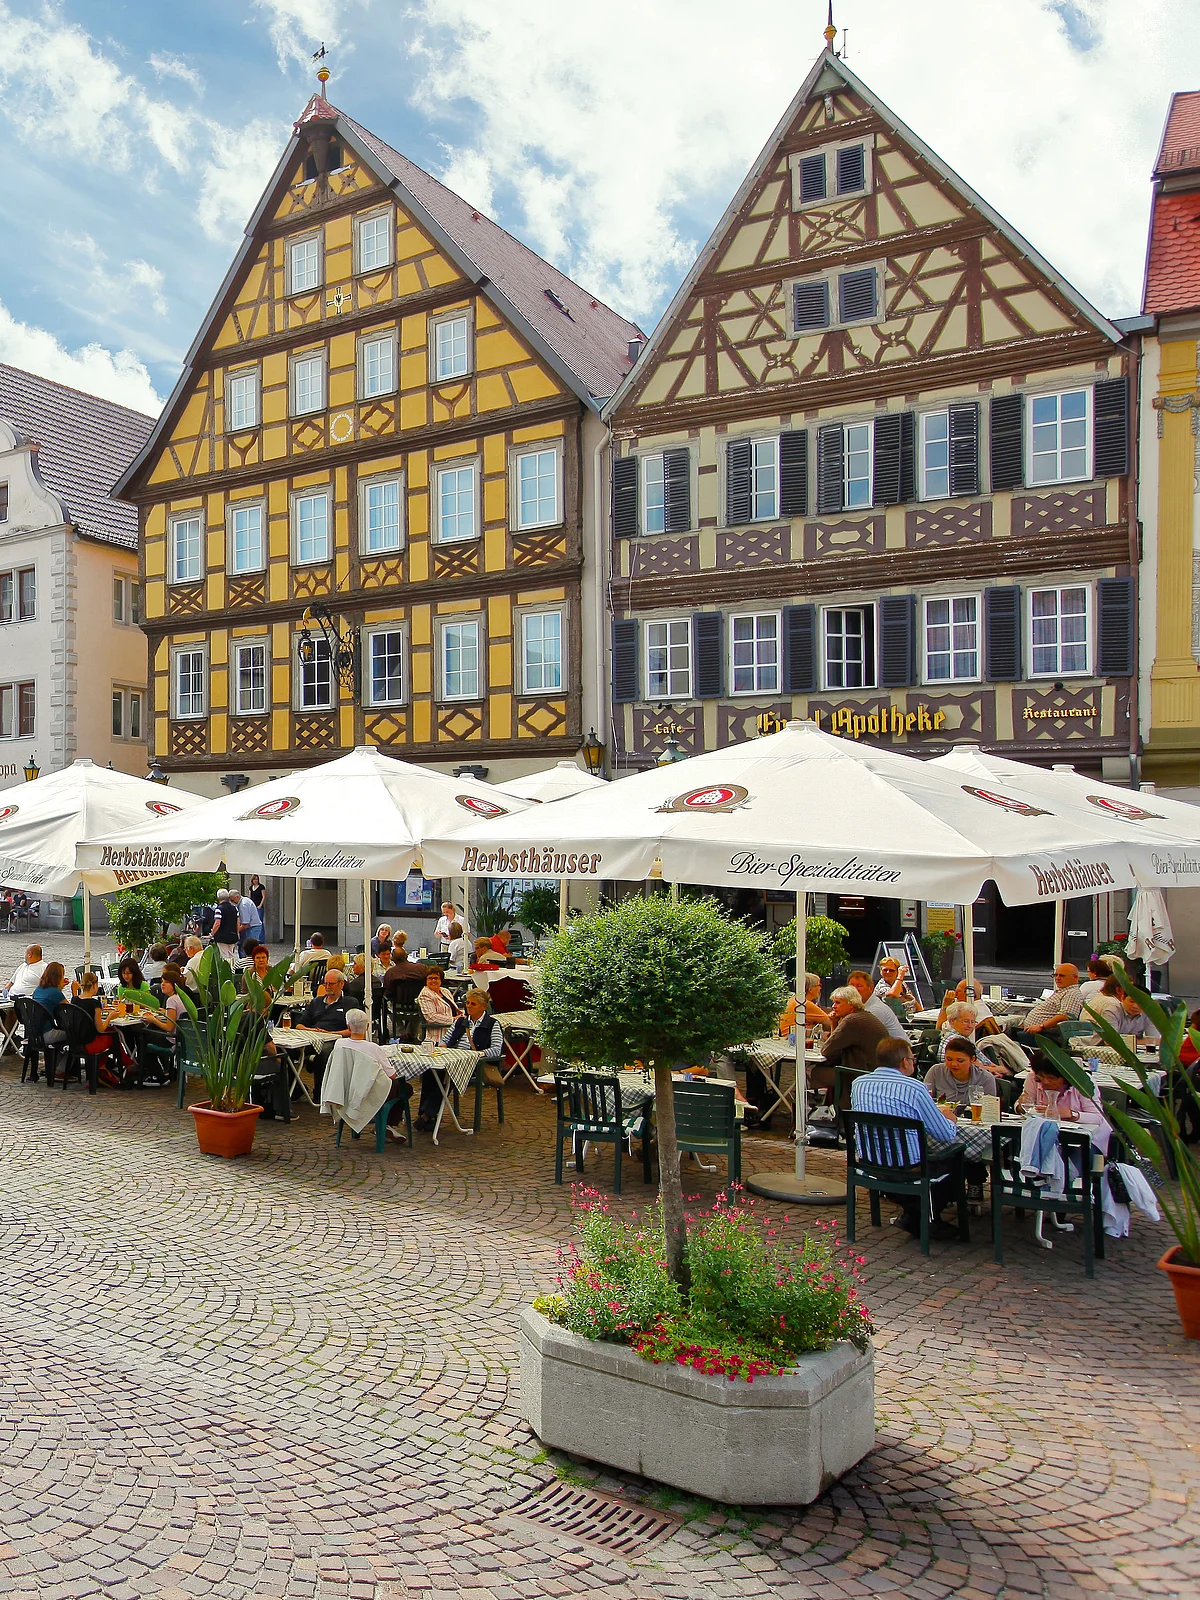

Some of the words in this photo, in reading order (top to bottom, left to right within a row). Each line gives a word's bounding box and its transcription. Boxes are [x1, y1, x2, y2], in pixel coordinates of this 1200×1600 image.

[831, 704, 947, 739] Apotheke
[1022, 706, 1098, 719] Restaurant
[654, 722, 684, 735] Cafe
[100, 846, 190, 868] Herbsthäuser
[264, 848, 366, 875] Bier-Spezialitäten
[460, 846, 602, 874] Herbsthäuser
[726, 851, 902, 887] Bier-Spezialitäten
[1028, 858, 1115, 896] Herbsthäuser
